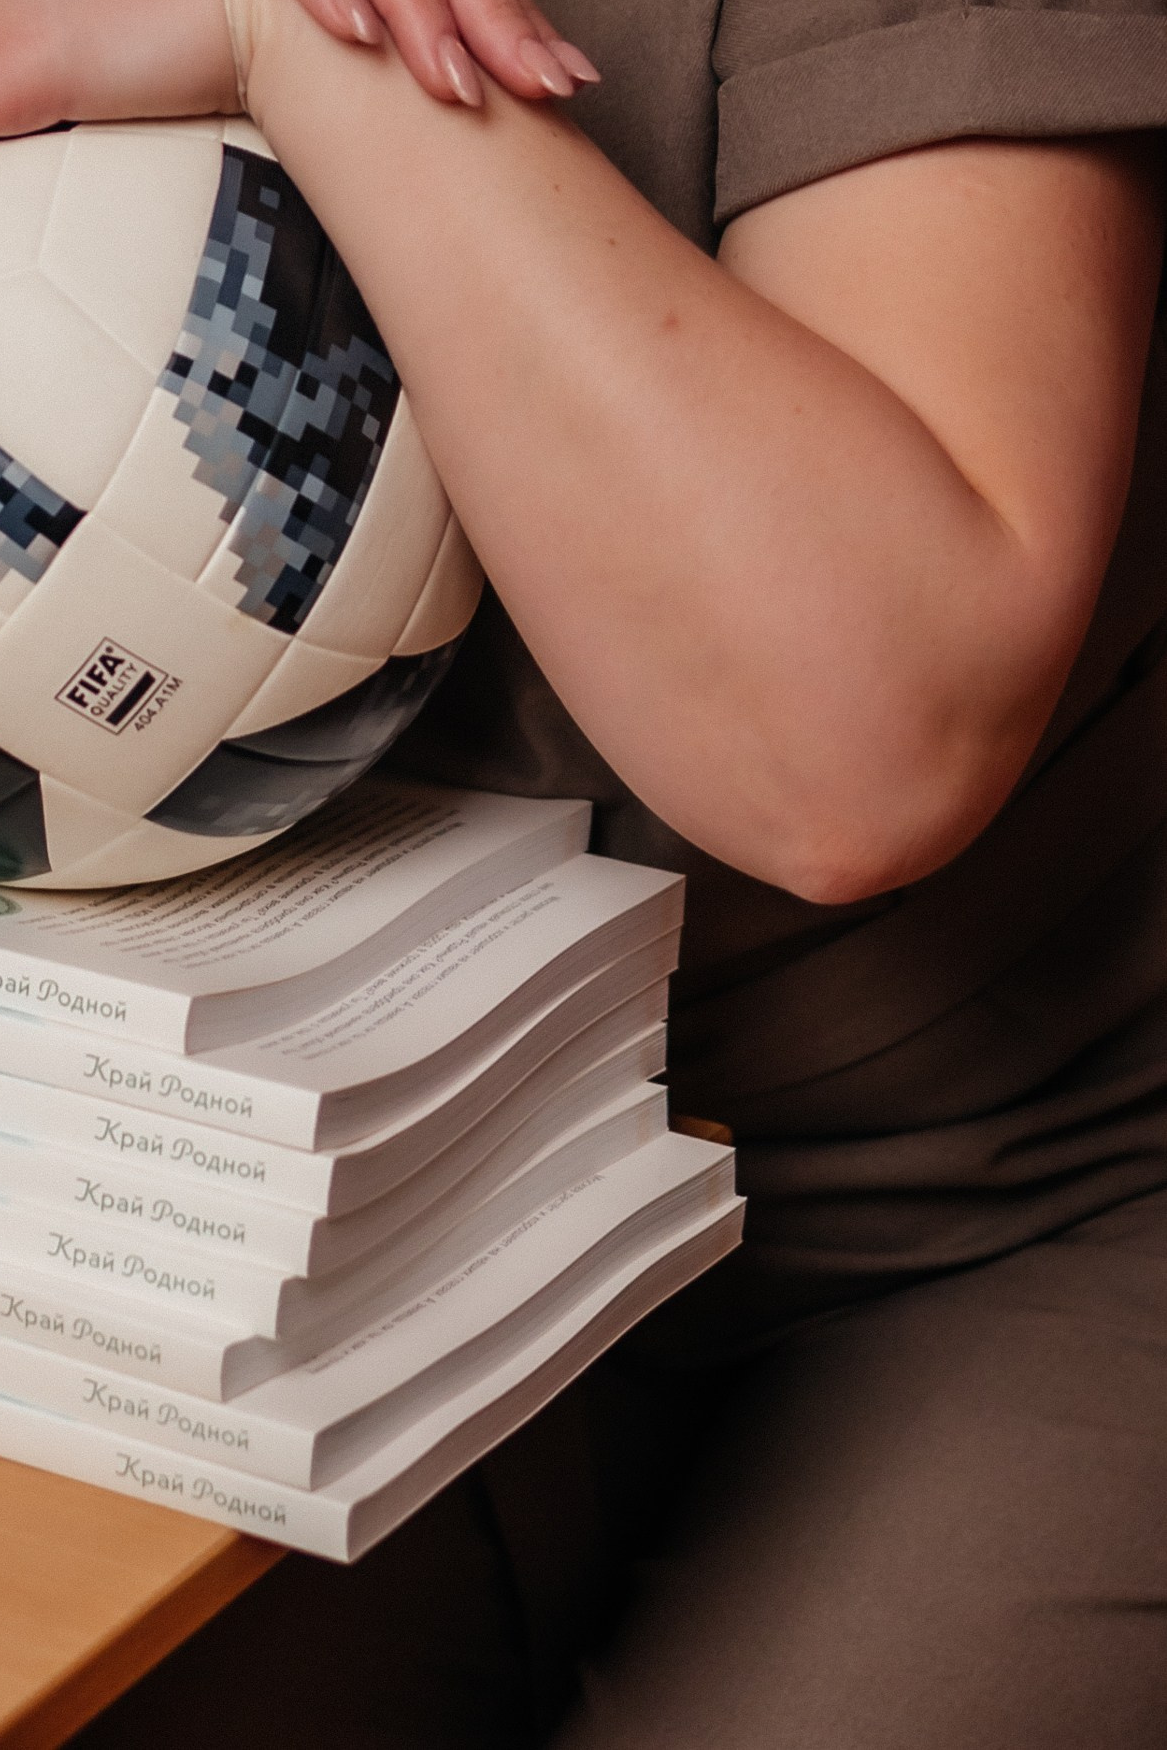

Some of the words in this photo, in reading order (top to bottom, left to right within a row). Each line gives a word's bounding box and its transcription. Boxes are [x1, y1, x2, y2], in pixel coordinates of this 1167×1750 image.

[66, 653, 125, 708] FIFA
[90, 663, 138, 717] QUALITY
[35, 978, 128, 1023] Родной
[82, 1052, 152, 1094] Край
[157, 1073, 253, 1119] Родной
[93, 1115, 164, 1157] Край
[169, 1137, 267, 1184] Родной
[73, 1176, 145, 1218] Край
[149, 1198, 247, 1245] Родной
[46, 1231, 116, 1273] Край
[121, 1253, 216, 1301] Родной
[0, 1292, 66, 1336] Край
[71, 1317, 162, 1365] Родной
[82, 1377, 150, 1421] Край
[156, 1402, 250, 1452] Родной
[115, 1451, 185, 1496] Край
[191, 1477, 287, 1527] Родной
